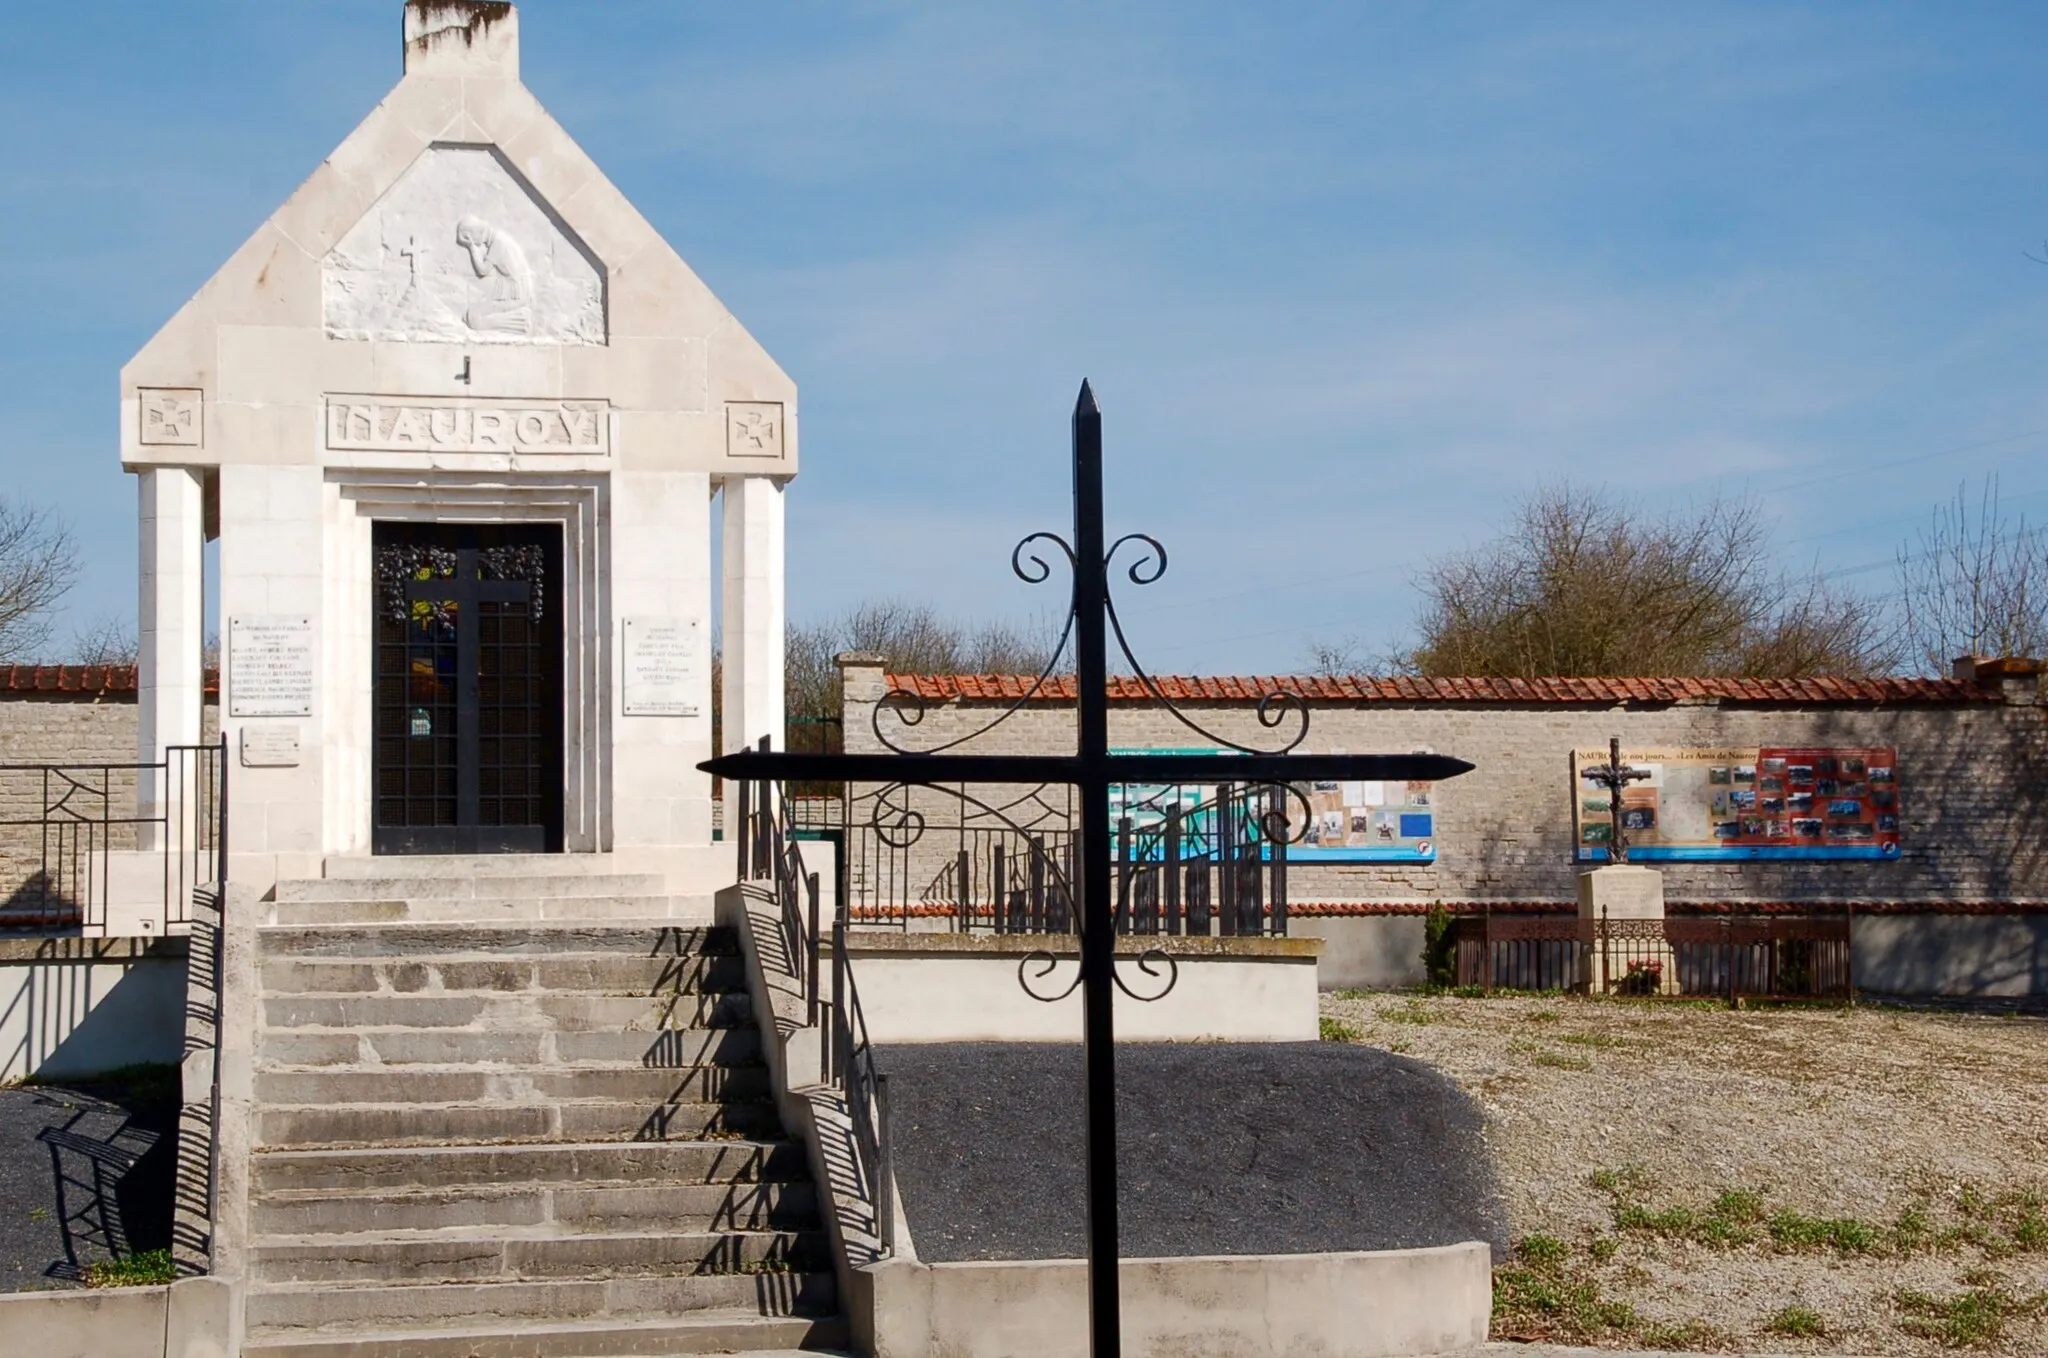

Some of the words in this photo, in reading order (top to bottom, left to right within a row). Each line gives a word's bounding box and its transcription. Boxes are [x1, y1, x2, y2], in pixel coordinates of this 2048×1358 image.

[343, 405, 590, 445] NAUROY
[1578, 752, 1611, 761] NAURO
[1695, 751, 1716, 760] Amis
[1717, 751, 1727, 760] de
